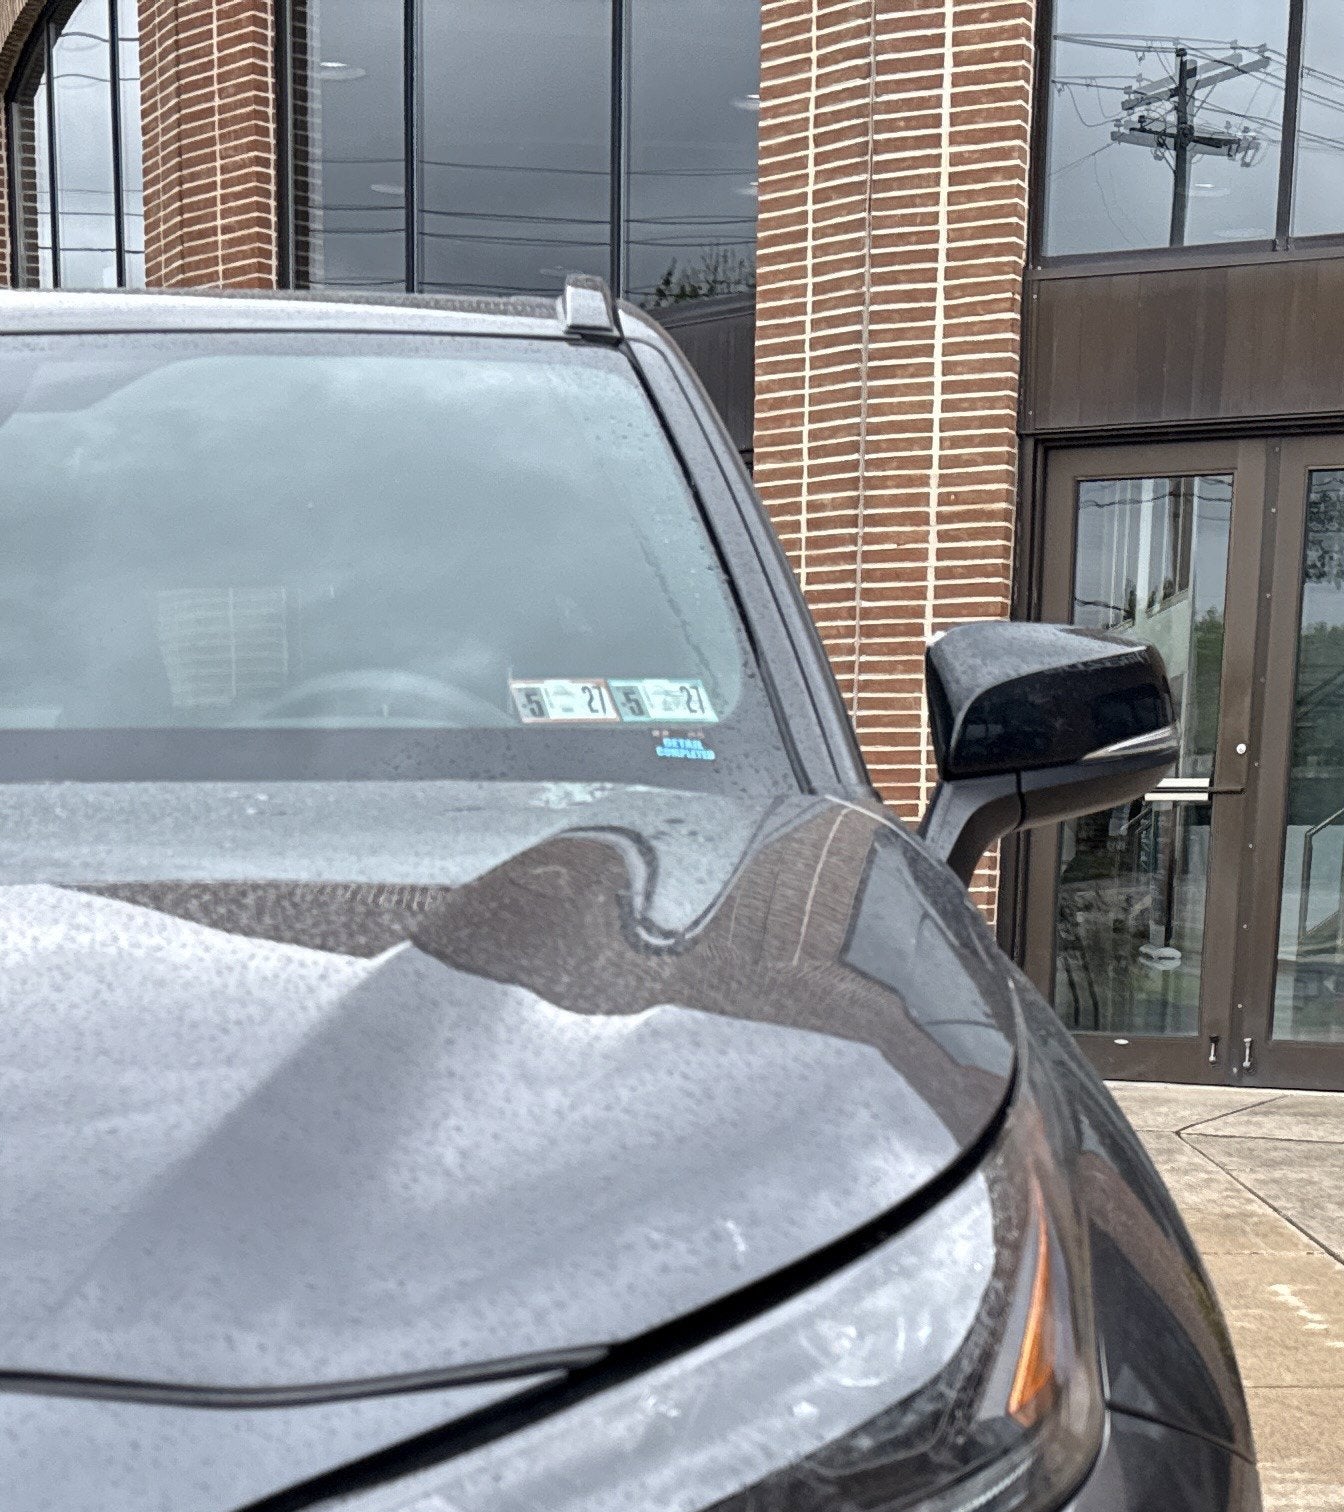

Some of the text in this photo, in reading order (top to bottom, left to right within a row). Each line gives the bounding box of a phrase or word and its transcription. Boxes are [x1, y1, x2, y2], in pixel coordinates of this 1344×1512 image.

[524, 685, 607, 718] 5 27
[622, 685, 706, 717] 5 27
